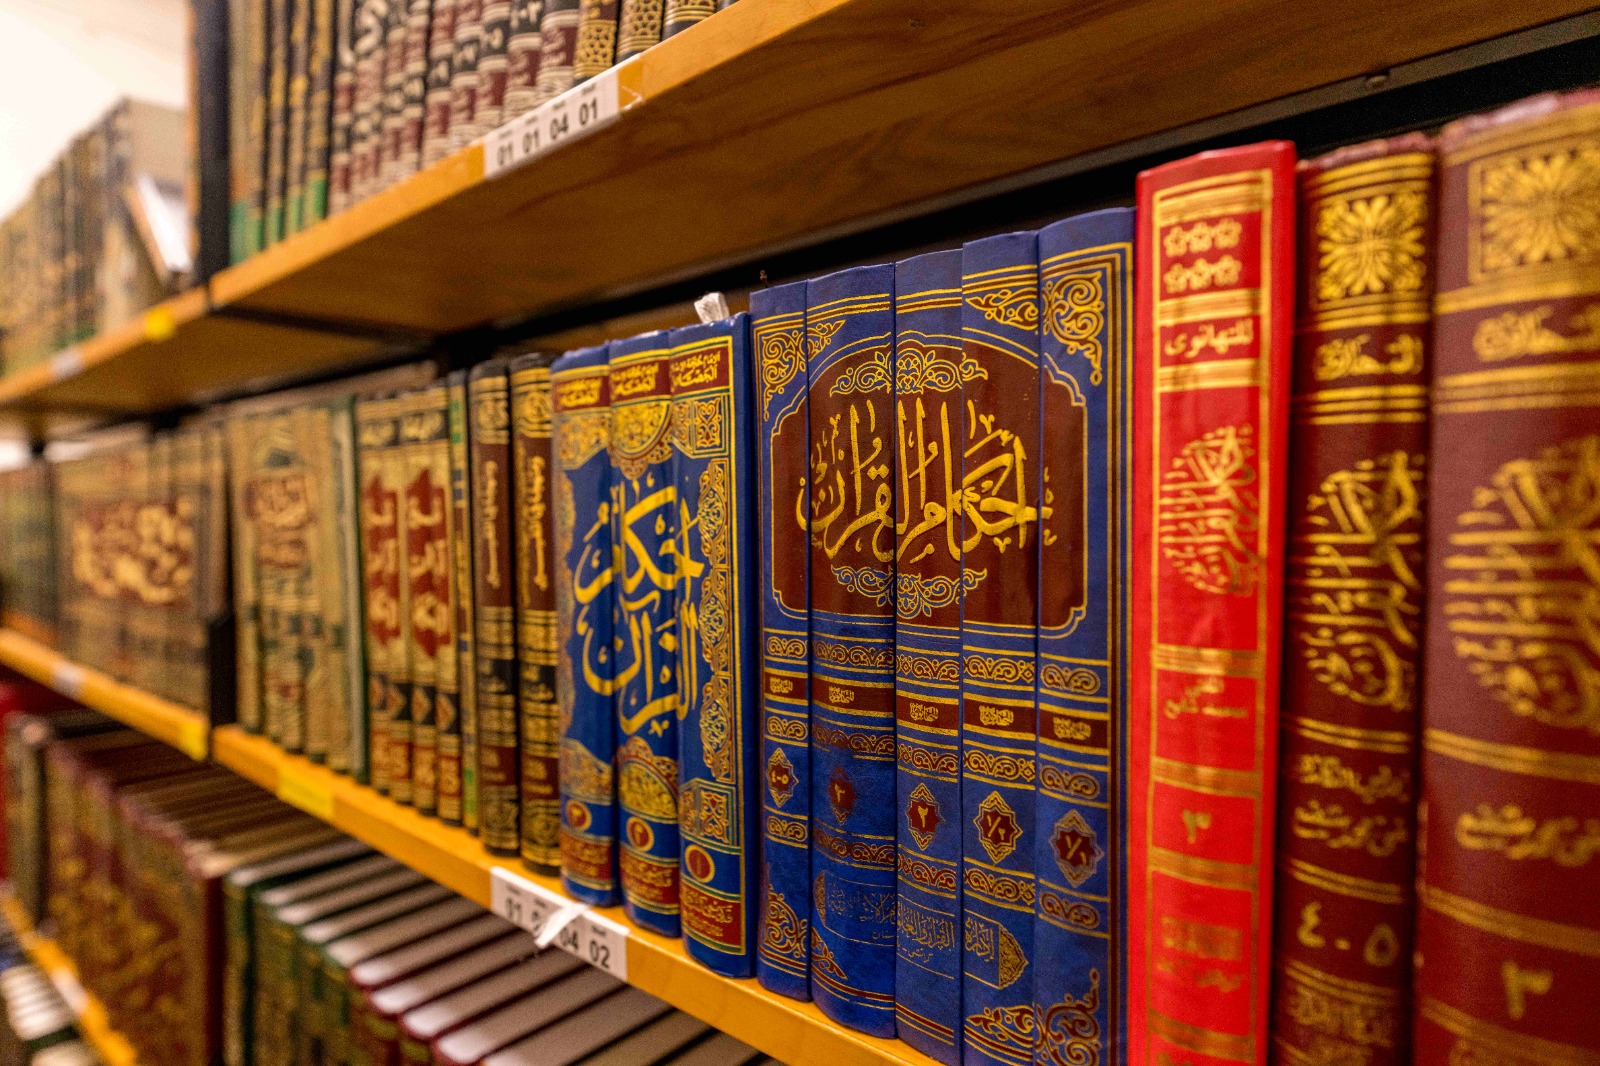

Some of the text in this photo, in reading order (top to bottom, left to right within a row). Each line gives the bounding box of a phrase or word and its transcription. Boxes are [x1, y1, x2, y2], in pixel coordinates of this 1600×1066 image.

[549, 113, 569, 140] 04
[579, 97, 599, 126] 01
[590, 939, 610, 969] 02
